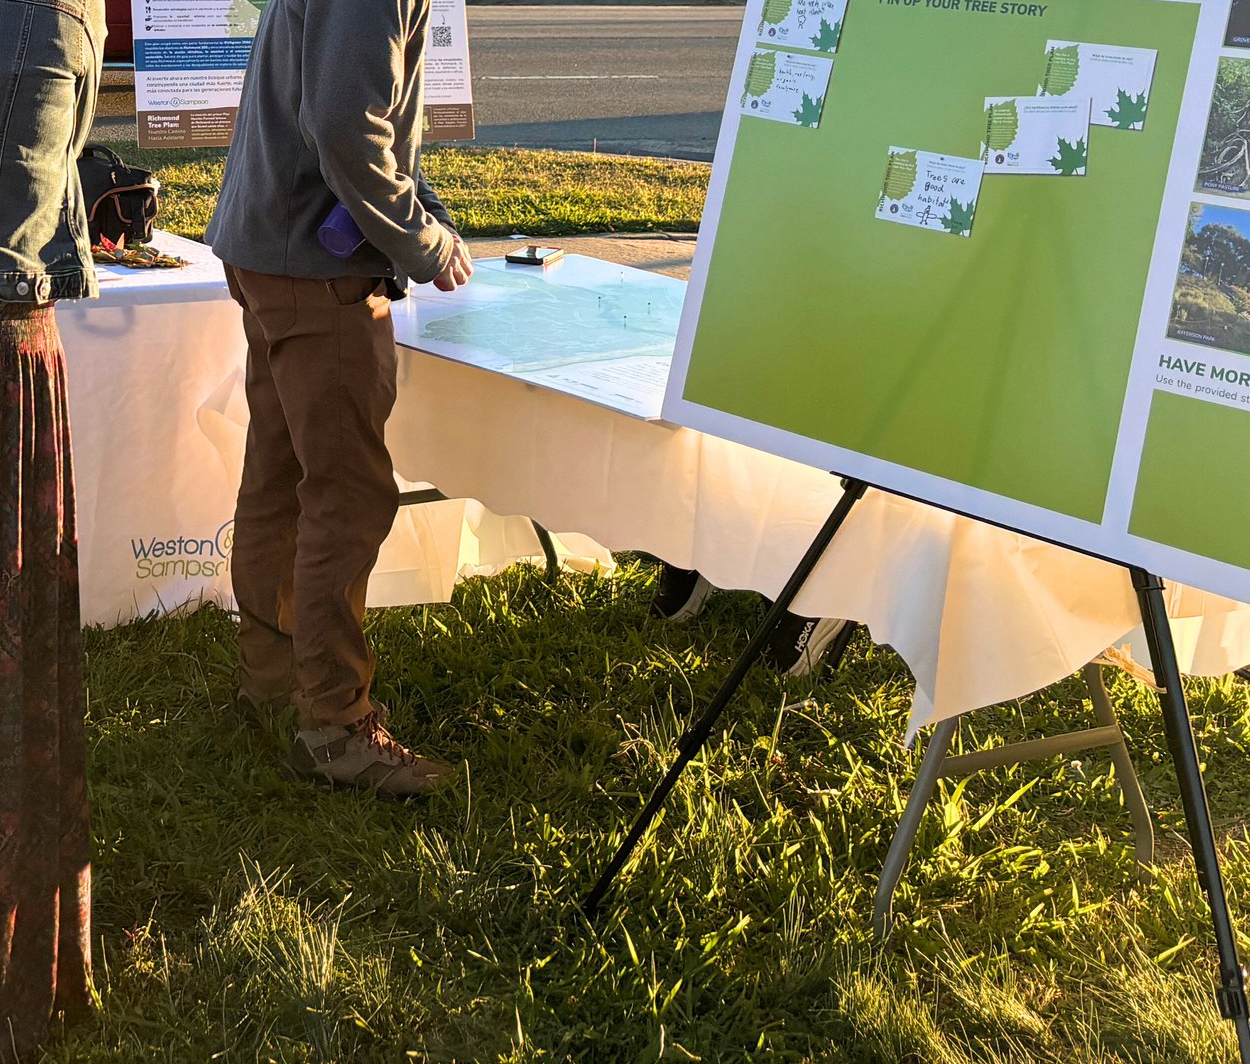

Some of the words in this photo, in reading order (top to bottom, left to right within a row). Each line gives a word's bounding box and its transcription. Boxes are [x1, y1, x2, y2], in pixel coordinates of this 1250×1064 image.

[964, 0, 997, 13] TREE
[1000, 2, 1048, 17] STORY
[924, 182, 944, 192] good
[926, 170, 948, 182] Trees
[951, 176, 966, 185] are
[1159, 354, 1206, 376] HAVE
[1156, 374, 1173, 385] Use
[1177, 379, 1192, 389] the
[1195, 385, 1238, 400] provided
[131, 536, 213, 559] Weston
